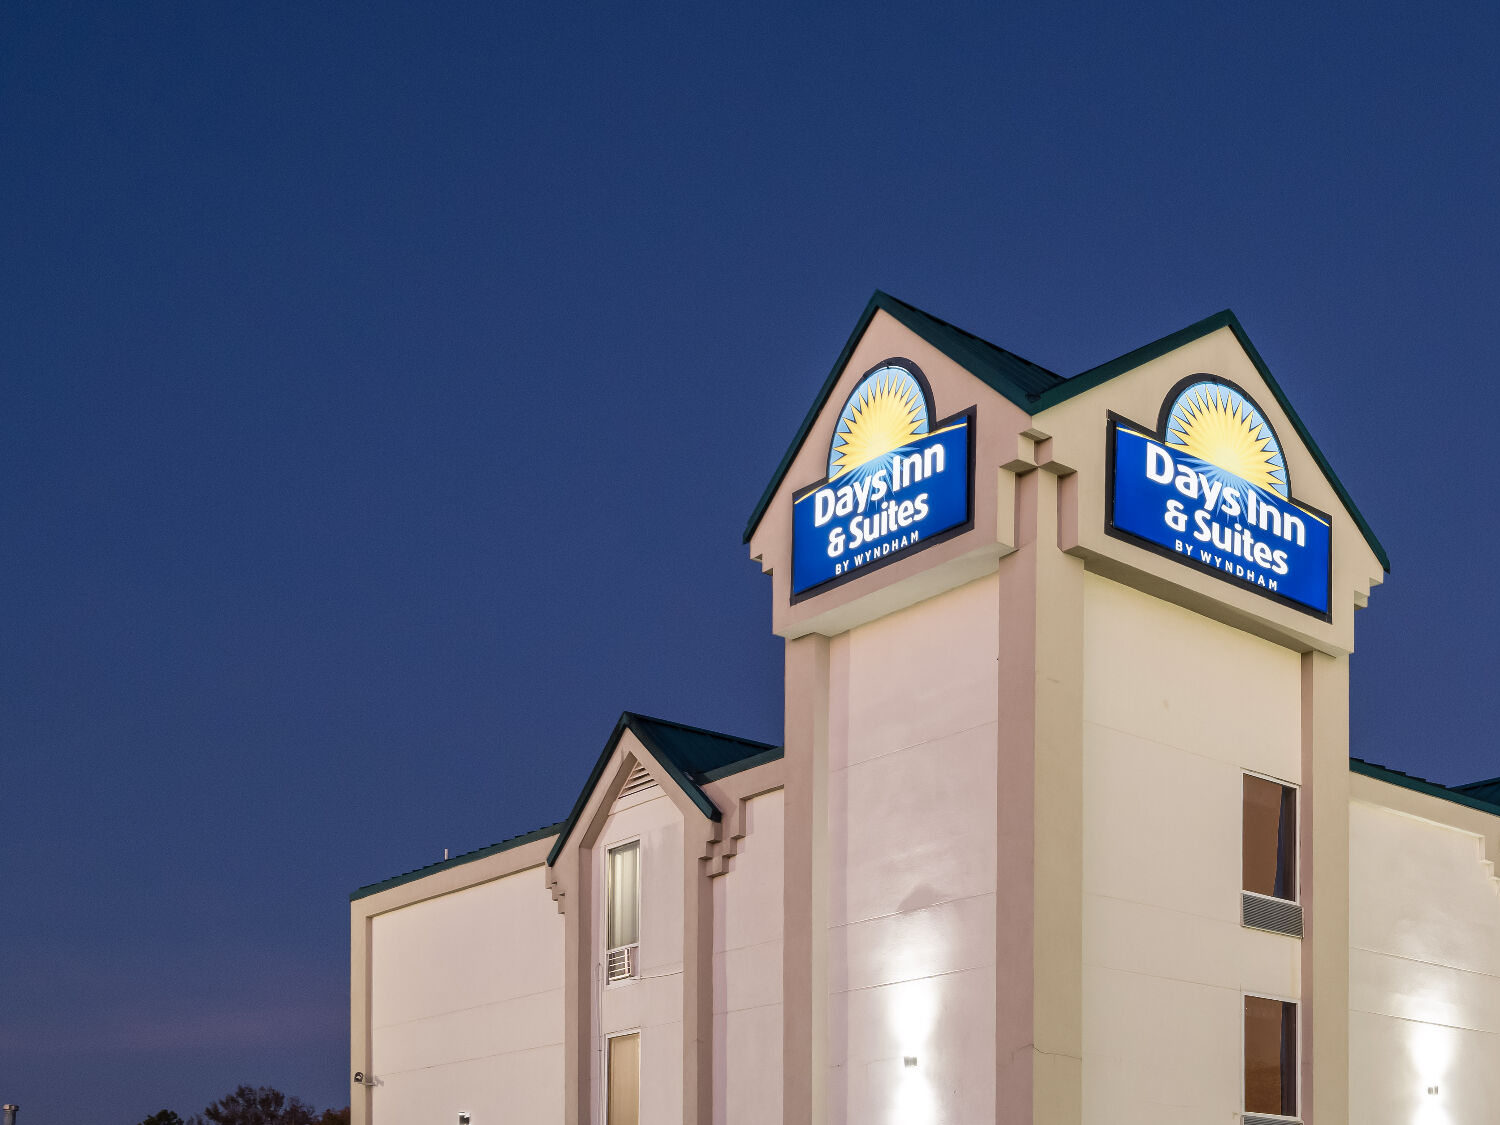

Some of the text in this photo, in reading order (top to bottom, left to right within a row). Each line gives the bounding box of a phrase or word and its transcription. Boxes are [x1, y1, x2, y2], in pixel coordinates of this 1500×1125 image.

[814, 443, 945, 528] Days Inn
[1146, 441, 1306, 548] Days Inn
[827, 493, 929, 558] & Suites
[835, 530, 919, 575] BY WYNDHAM
[1164, 499, 1289, 575] & Suites
[1175, 539, 1278, 591] BY WYNDHAM
